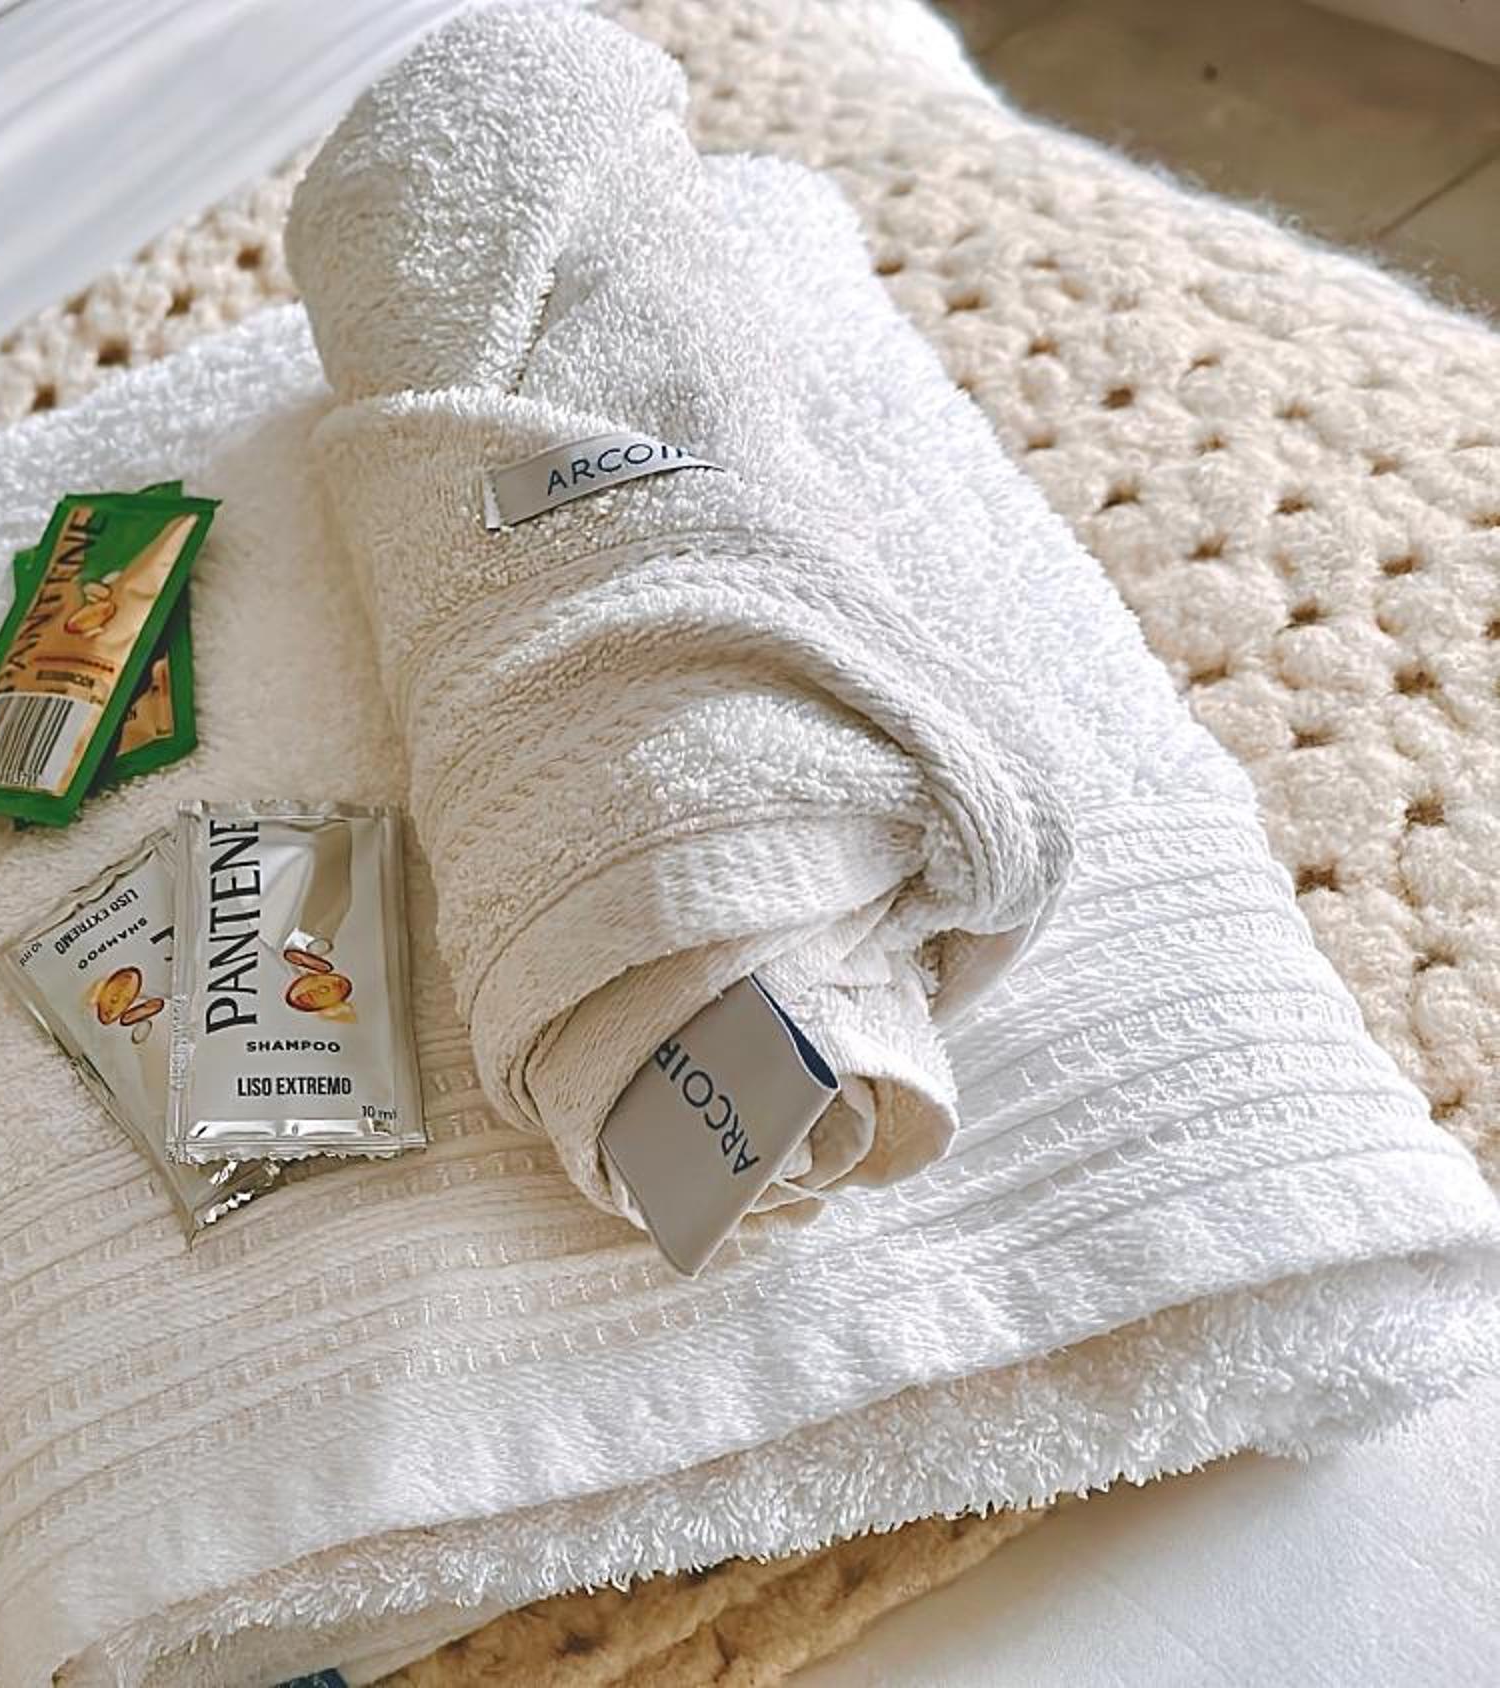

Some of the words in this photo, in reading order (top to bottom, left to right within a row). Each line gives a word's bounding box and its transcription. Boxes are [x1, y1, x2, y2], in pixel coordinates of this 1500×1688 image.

[110, 888, 139, 913] LISO
[54, 911, 110, 955] EXTREMO
[205, 819, 260, 1034] PANTENE
[78, 917, 148, 970] SHAMPOO
[246, 1040, 341, 1053] SHAMPOO
[237, 1077, 272, 1097] LISO
[276, 1077, 352, 1095] EXTREMO
[362, 1105, 376, 1118] 10
